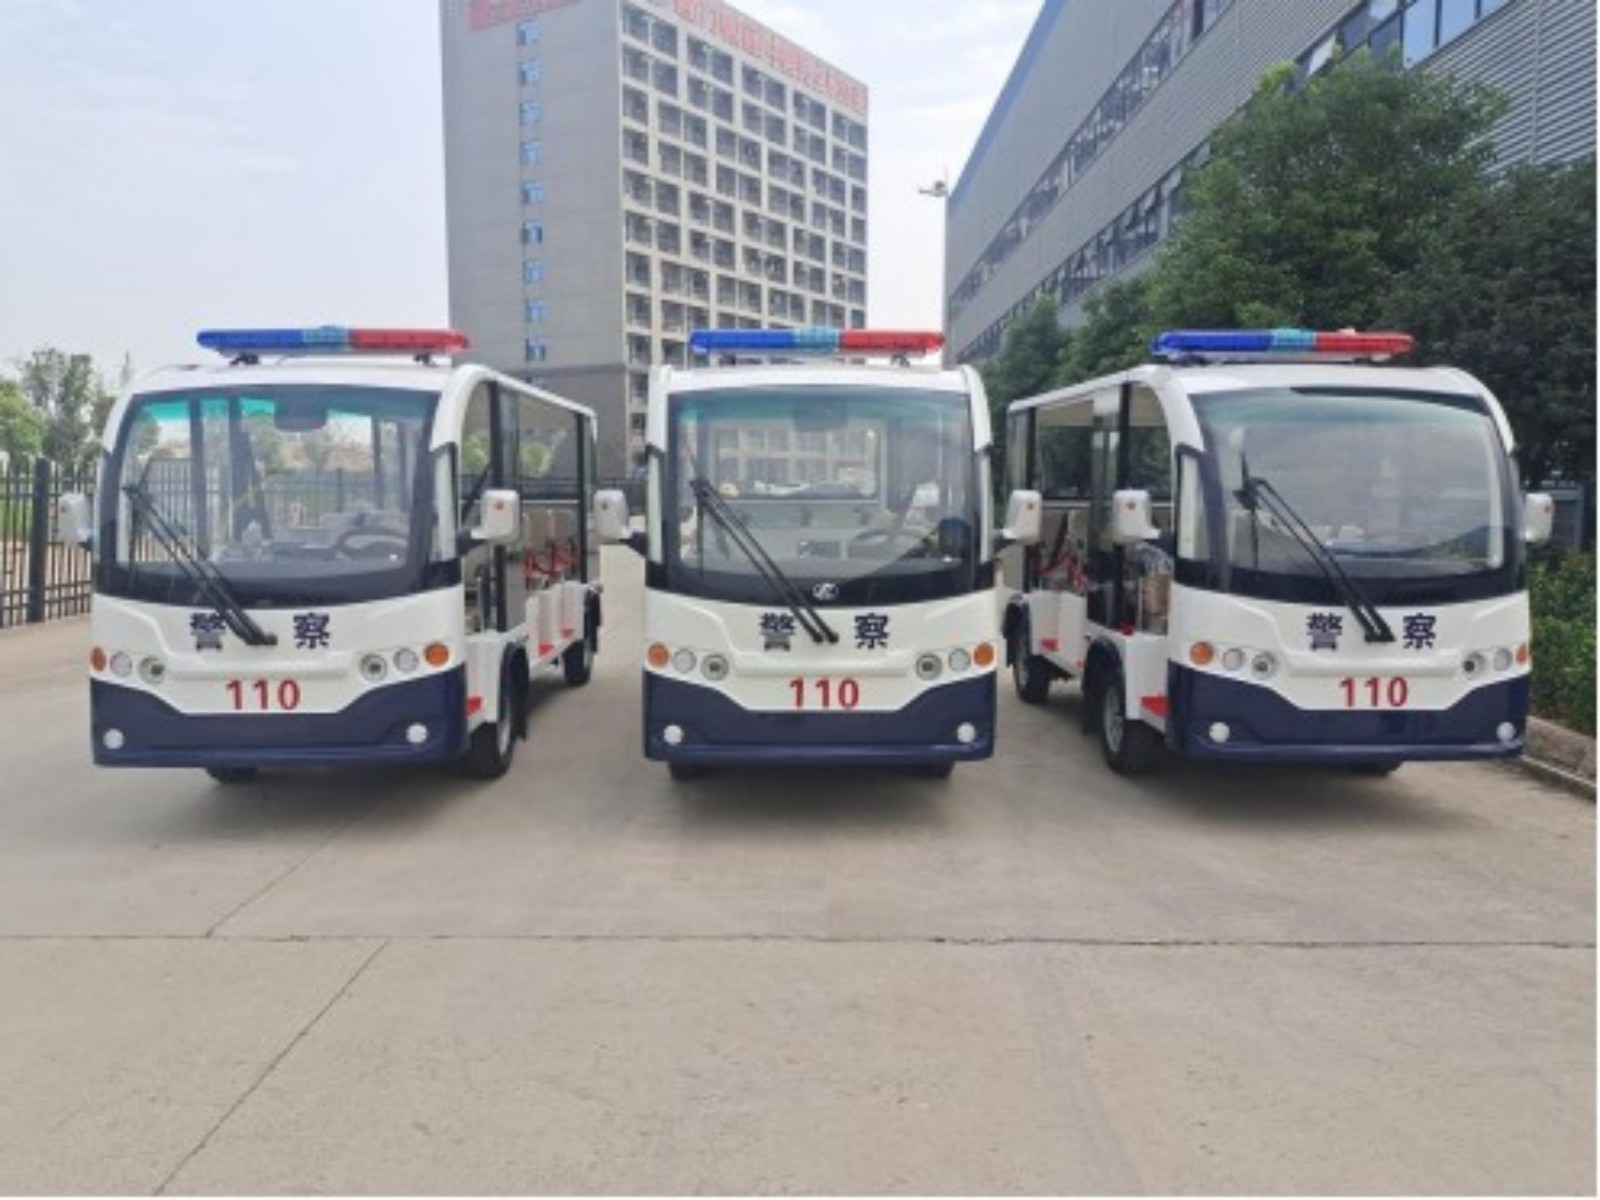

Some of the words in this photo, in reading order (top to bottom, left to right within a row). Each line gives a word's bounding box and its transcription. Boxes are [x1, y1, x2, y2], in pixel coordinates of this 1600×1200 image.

[226, 679, 301, 711] 110
[789, 678, 860, 708] 110
[1339, 676, 1409, 708] 110
